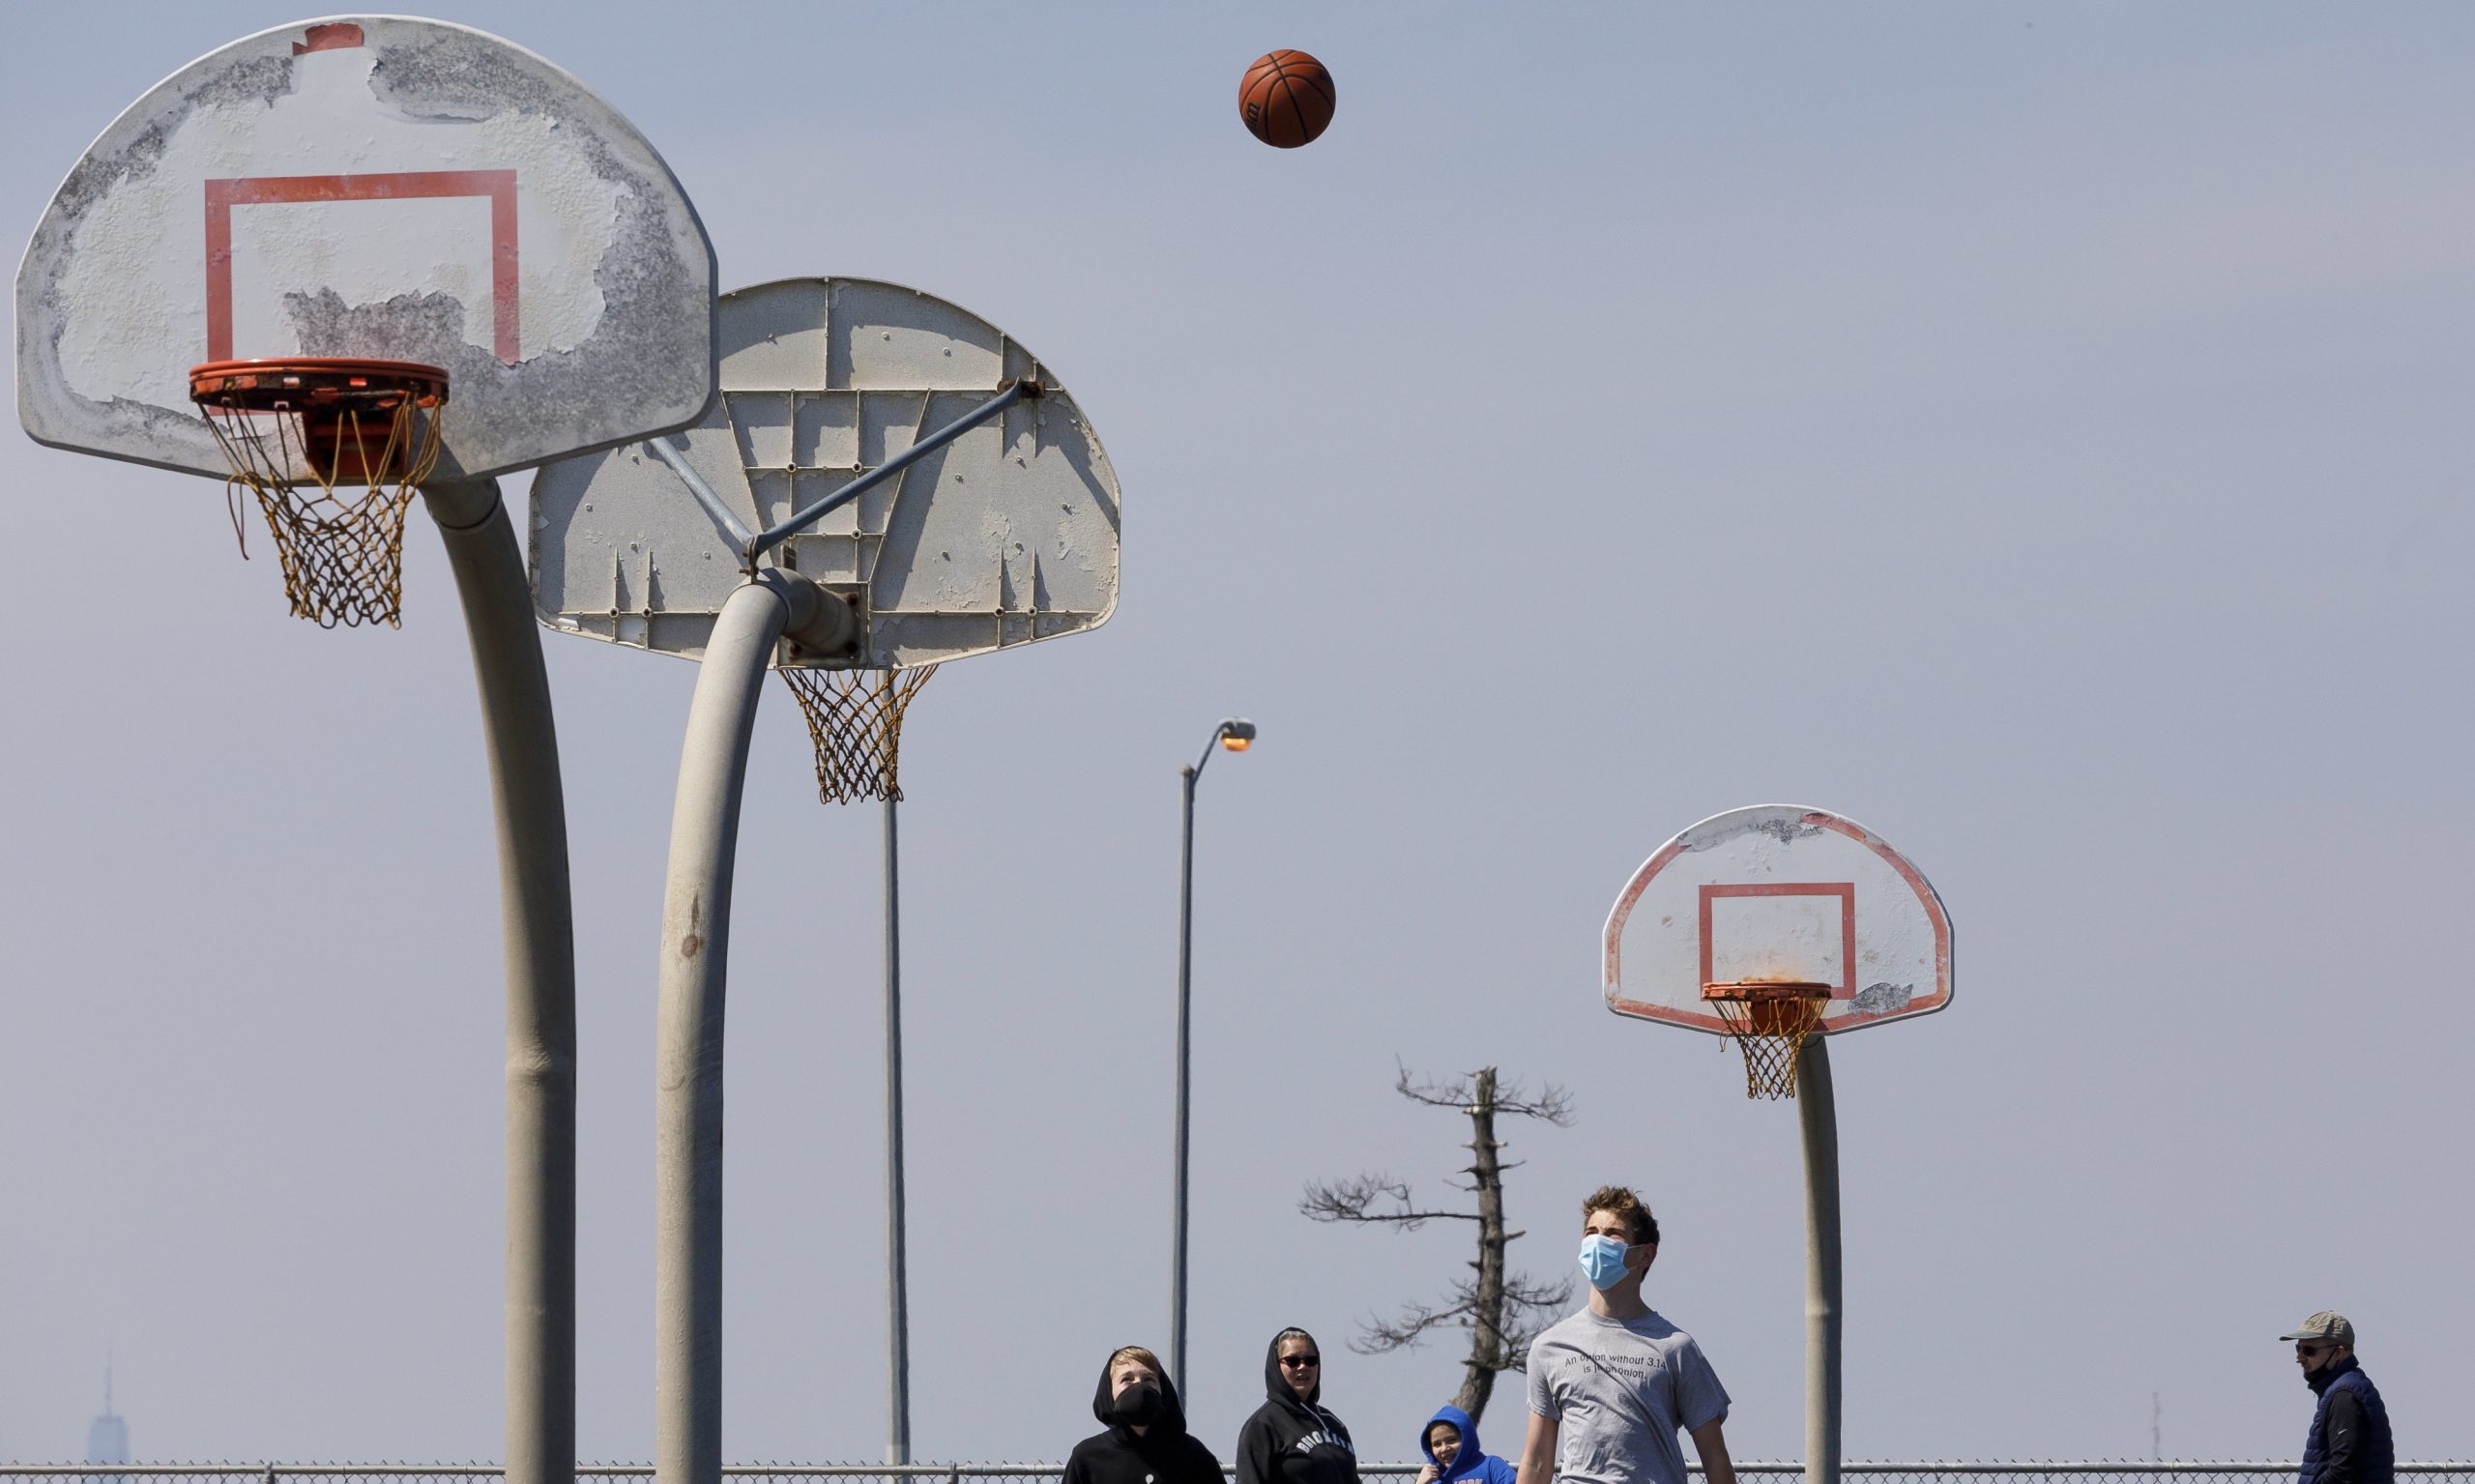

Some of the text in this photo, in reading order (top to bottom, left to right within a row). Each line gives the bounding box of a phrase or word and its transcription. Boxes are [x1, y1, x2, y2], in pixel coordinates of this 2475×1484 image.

[1565, 1353, 1667, 1369] An oion without 3.14
[1583, 1364, 1591, 1374] is
[1617, 1367, 1647, 1380] onion.
